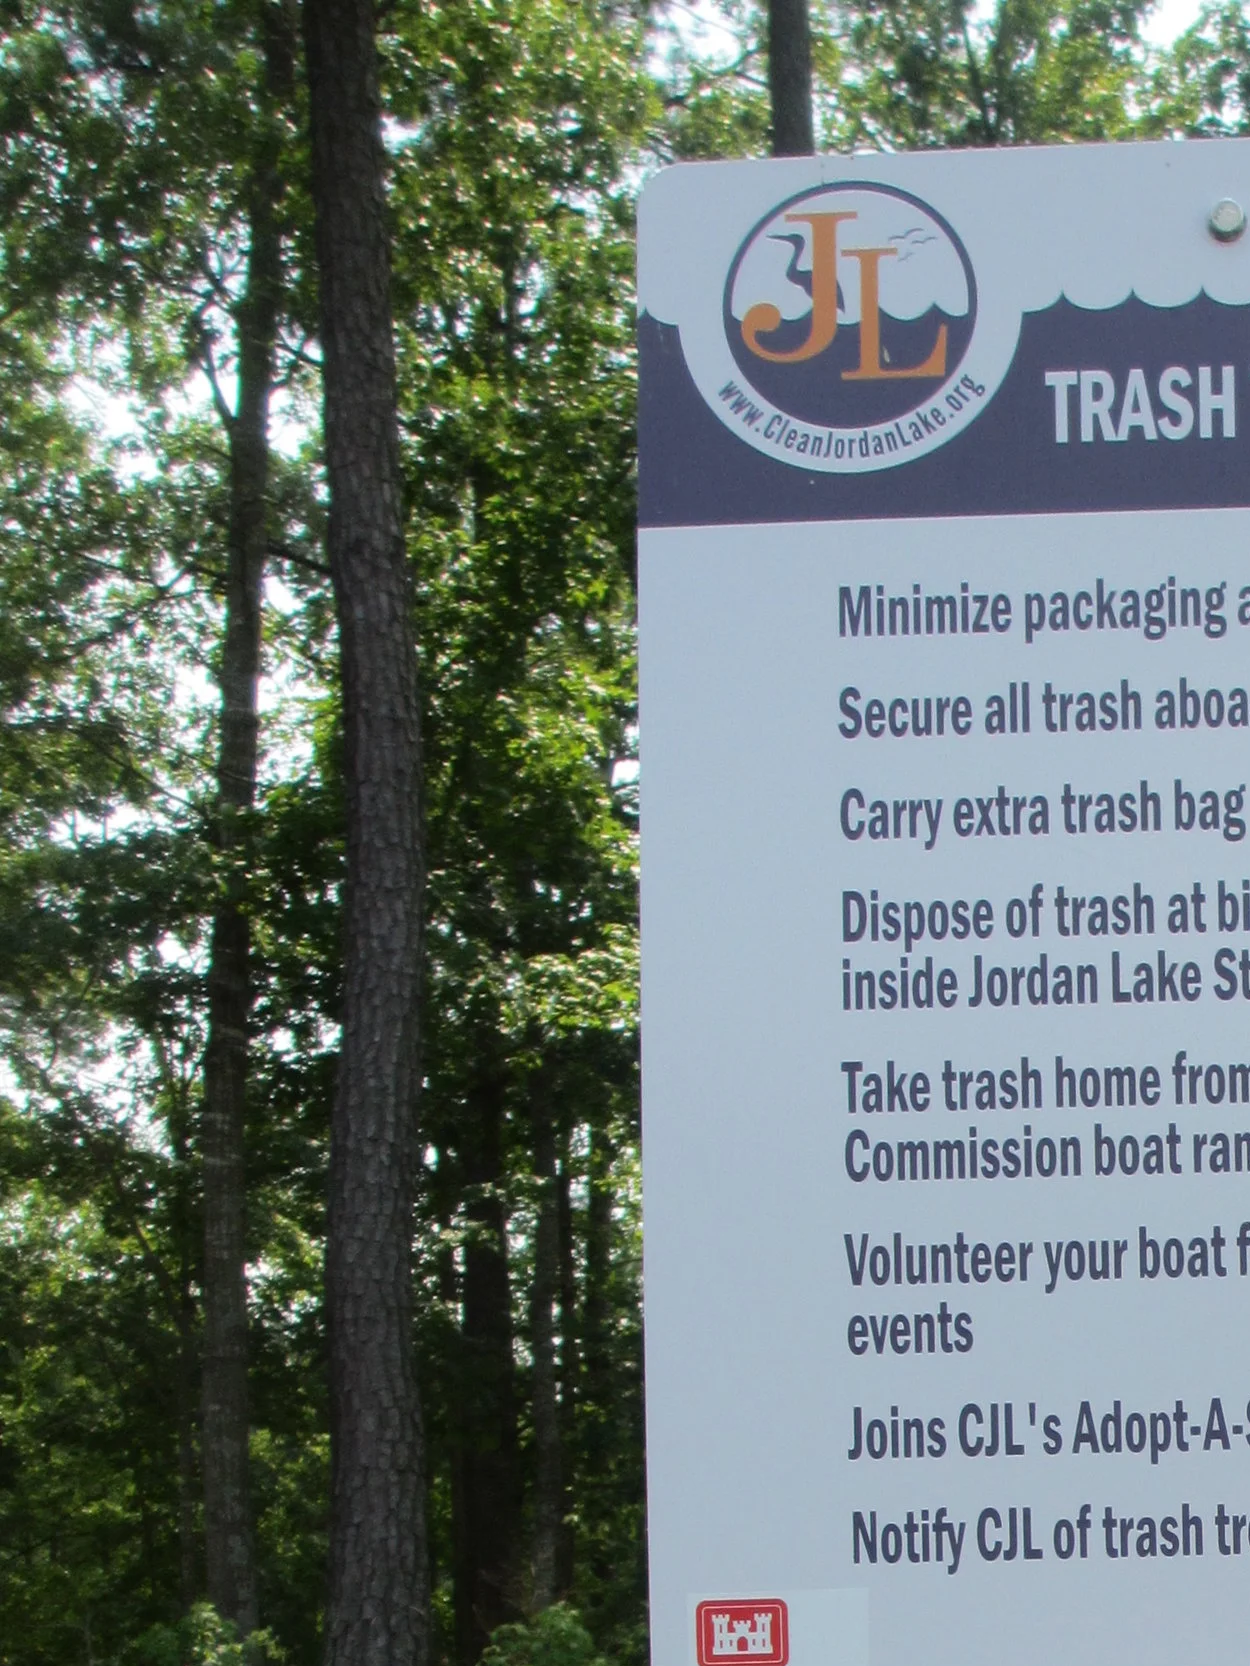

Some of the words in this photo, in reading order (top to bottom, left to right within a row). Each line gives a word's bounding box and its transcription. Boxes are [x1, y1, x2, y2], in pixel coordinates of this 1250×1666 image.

[718, 373, 986, 459] www.CleanJordanLake.org
[1044, 365, 1236, 444] TRASH
[839, 583, 1011, 636] Minimize
[1025, 576, 1227, 643] packaging
[839, 687, 972, 738] Secure
[985, 682, 1029, 734] all
[1042, 679, 1141, 732] trash
[840, 788, 942, 850] Carry
[953, 786, 1049, 837] extra
[1061, 780, 1161, 833] trash
[1175, 779, 1246, 841] bag
[843, 890, 993, 953] Dispose
[1006, 883, 1043, 937] of
[1055, 883, 1154, 936] trash
[1168, 883, 1206, 933] at
[843, 957, 957, 1010] inside
[969, 953, 1097, 1007] Jordan
[1112, 950, 1201, 1002] Lake
[841, 1061, 930, 1113] Take
[942, 1057, 1042, 1111] trash
[1056, 1056, 1160, 1107] home
[845, 1125, 1081, 1182] Commission
[1095, 1123, 1182, 1175] boat
[844, 1232, 1033, 1285] Volunteer
[1044, 1240, 1127, 1293] your
[1139, 1226, 1227, 1278] boat
[848, 1302, 973, 1355] events
[848, 1406, 946, 1460] Joins
[959, 1403, 1062, 1457] CJL's
[853, 1507, 966, 1575] Notify
[977, 1507, 1043, 1561] CJL
[1054, 1504, 1091, 1559] of
[1102, 1504, 1203, 1558] trash
